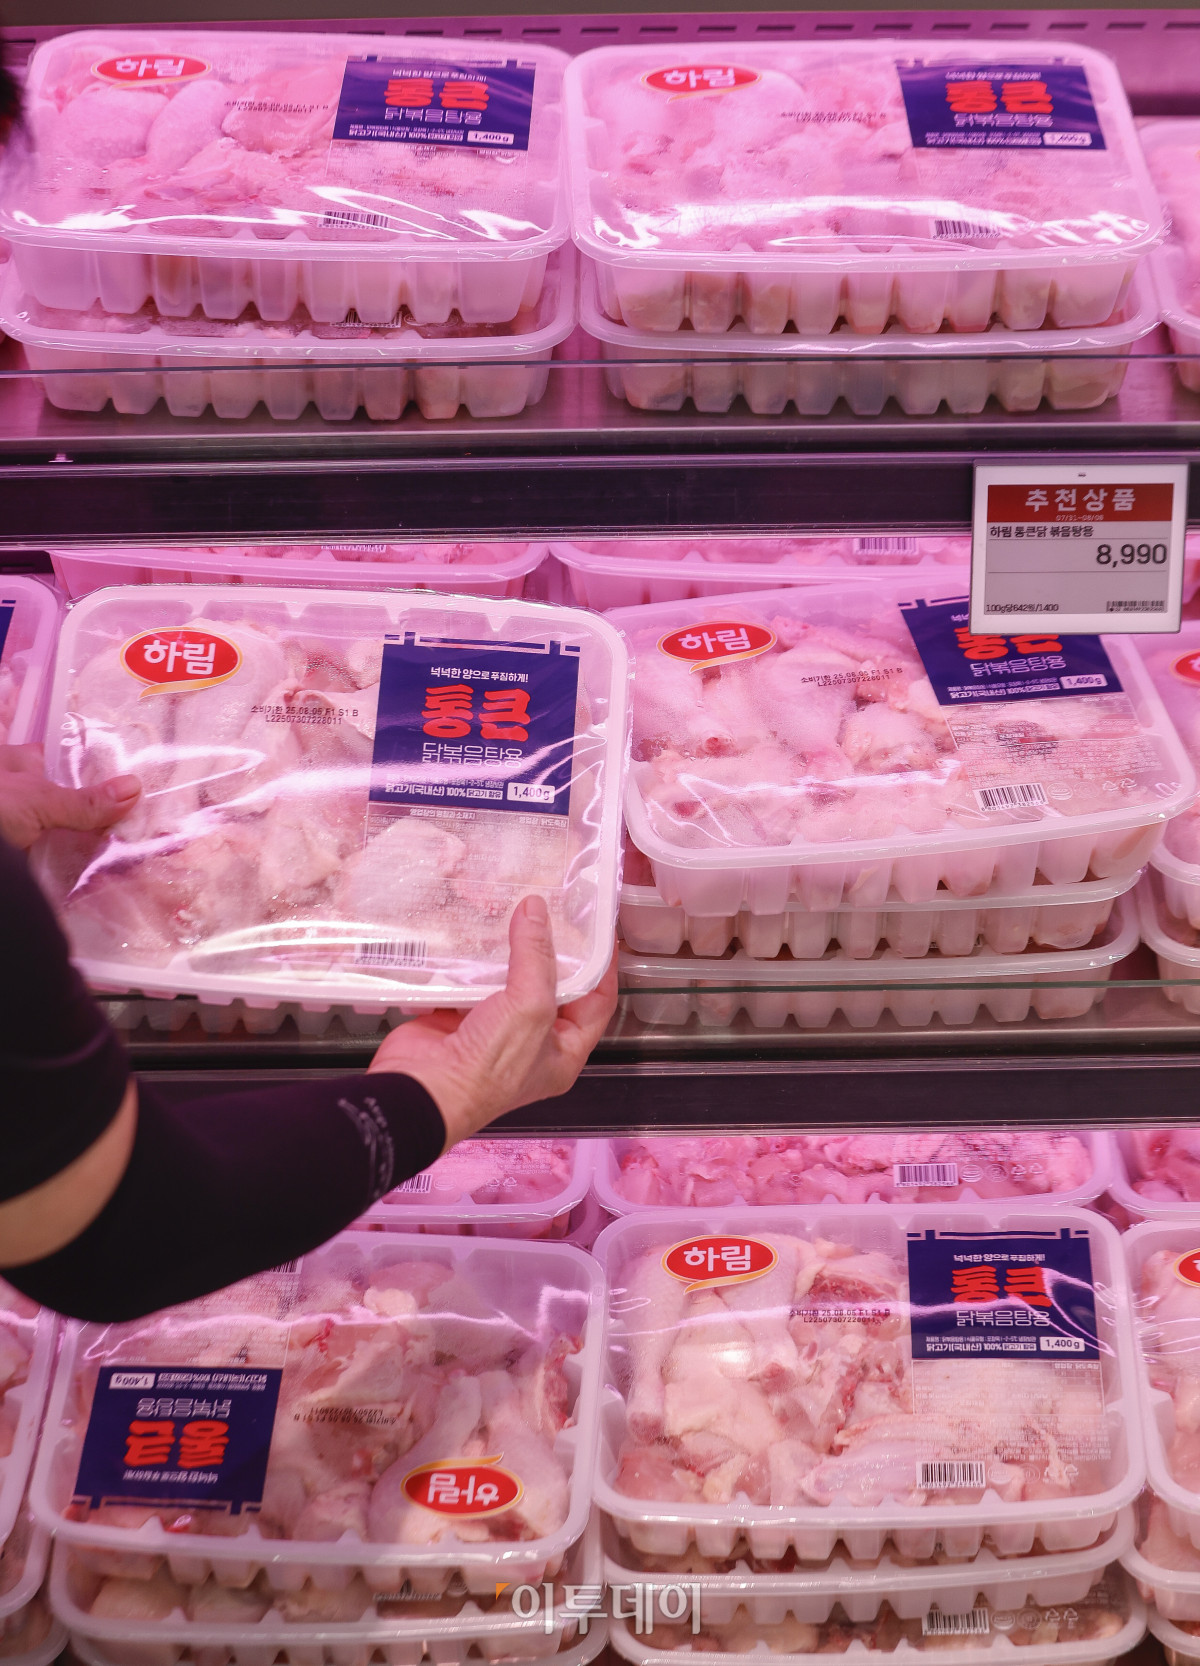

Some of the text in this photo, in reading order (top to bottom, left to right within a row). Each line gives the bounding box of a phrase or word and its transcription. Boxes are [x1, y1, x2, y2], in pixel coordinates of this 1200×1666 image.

[115, 58, 186, 78] 하림
[662, 67, 736, 89] 하림
[1024, 487, 1137, 513] 추천상품
[989, 525, 1095, 538] 하림 통큰닭 볶음탕용
[1095, 543, 1168, 568] 8,990
[677, 627, 751, 653] 하림
[143, 639, 217, 676] 하림
[969, 654, 1068, 678] 닭볶음탕용
[430, 666, 462, 680] 넉넉한
[462, 668, 490, 681] 양으로
[1065, 676, 1104, 687] 1,400g
[420, 684, 532, 743] 통큰
[421, 742, 523, 770] 닭볶음탕용
[512, 786, 551, 801] 1,400g
[683, 1244, 751, 1272] 하림
[953, 1253, 982, 1263] 넉넉한
[983, 1253, 1010, 1263] 양으로
[950, 1264, 1054, 1308] 통큰
[956, 1310, 1051, 1327] 닭볶음탕용
[1044, 1338, 1080, 1350] 1,400g
[113, 1374, 149, 1385] 1,400g
[123, 1419, 230, 1469] 통큰
[426, 1472, 500, 1507] 하림
